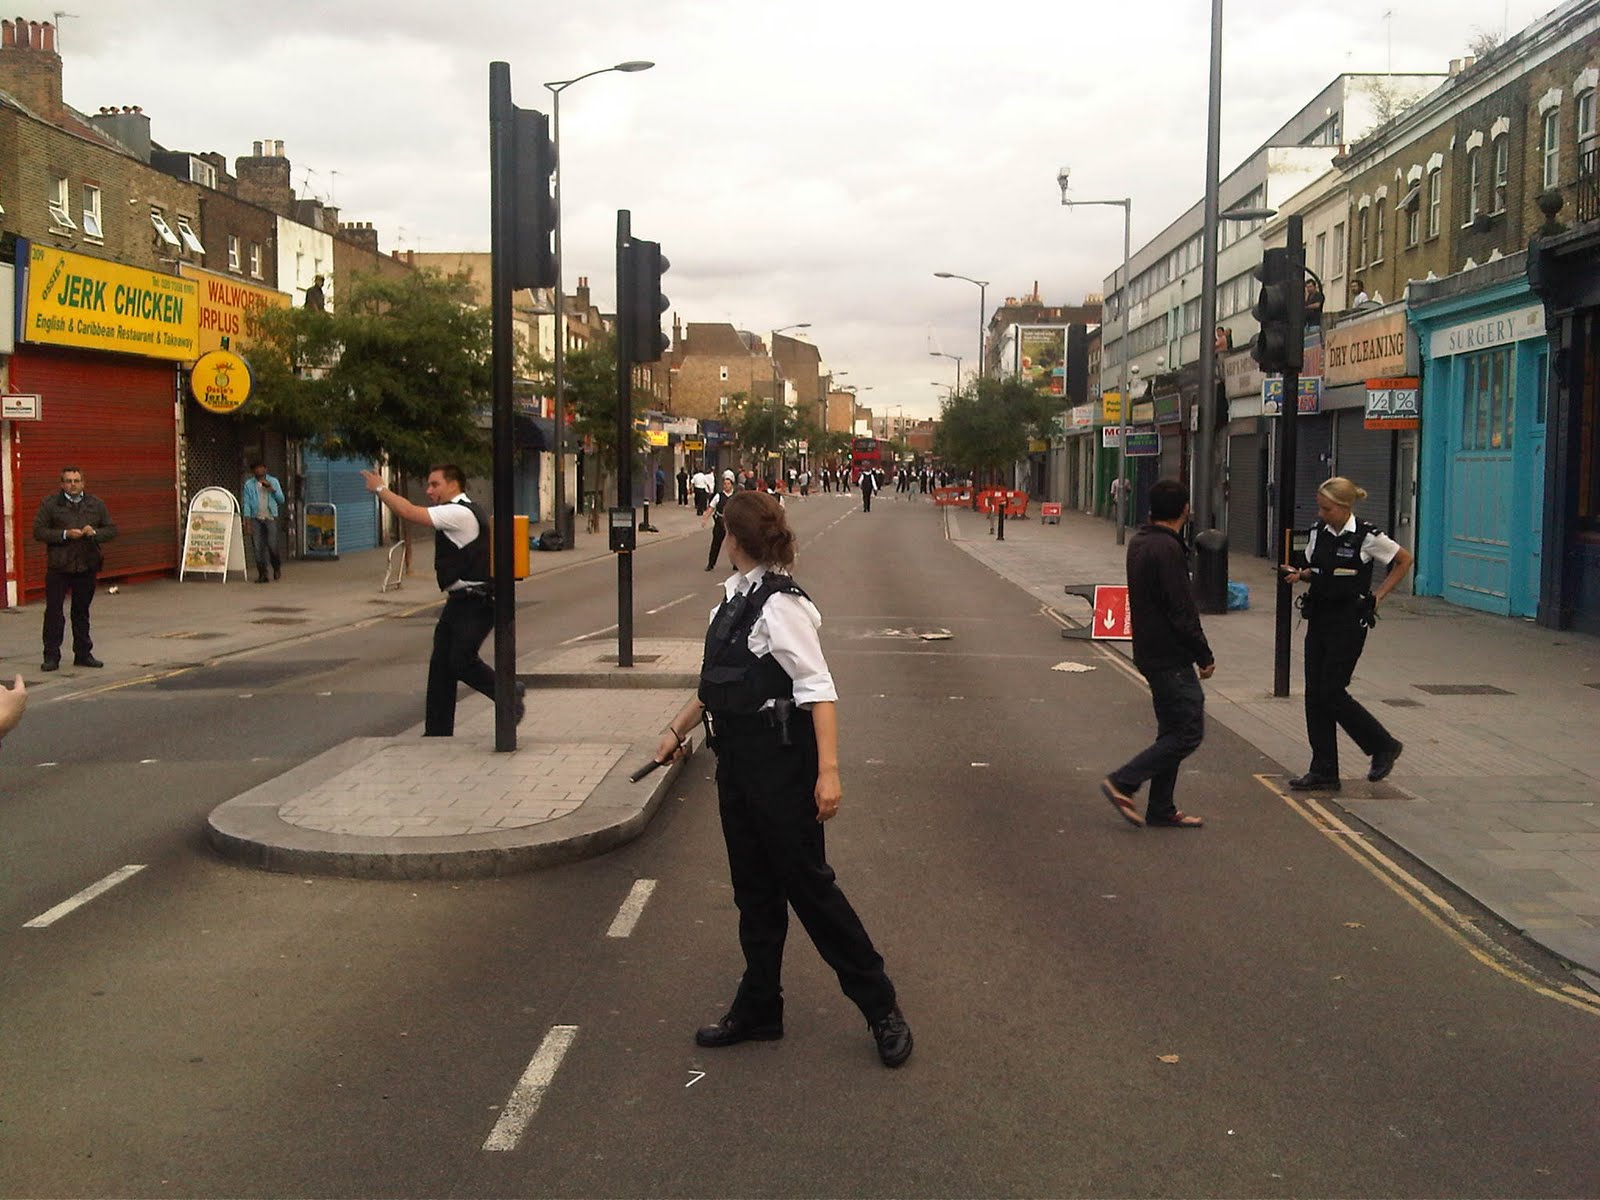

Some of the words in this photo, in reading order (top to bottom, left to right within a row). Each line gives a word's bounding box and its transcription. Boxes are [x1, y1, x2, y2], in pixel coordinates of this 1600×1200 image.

[57, 274, 108, 312] JERK
[114, 285, 183, 325] CHICKEN
[208, 280, 268, 312] WALWORTH
[36, 313, 65, 333] English
[68, 323, 74, 333] &
[77, 322, 115, 339] Caribbean
[117, 325, 155, 342] Restaurant
[156, 333, 162, 344] &
[199, 306, 239, 335] URPLUS
[1449, 317, 1516, 351] SURGERY
[1330, 345, 1348, 368] DRY
[1350, 333, 1404, 364] CLEANING
[1271, 380, 1316, 395] CFE
